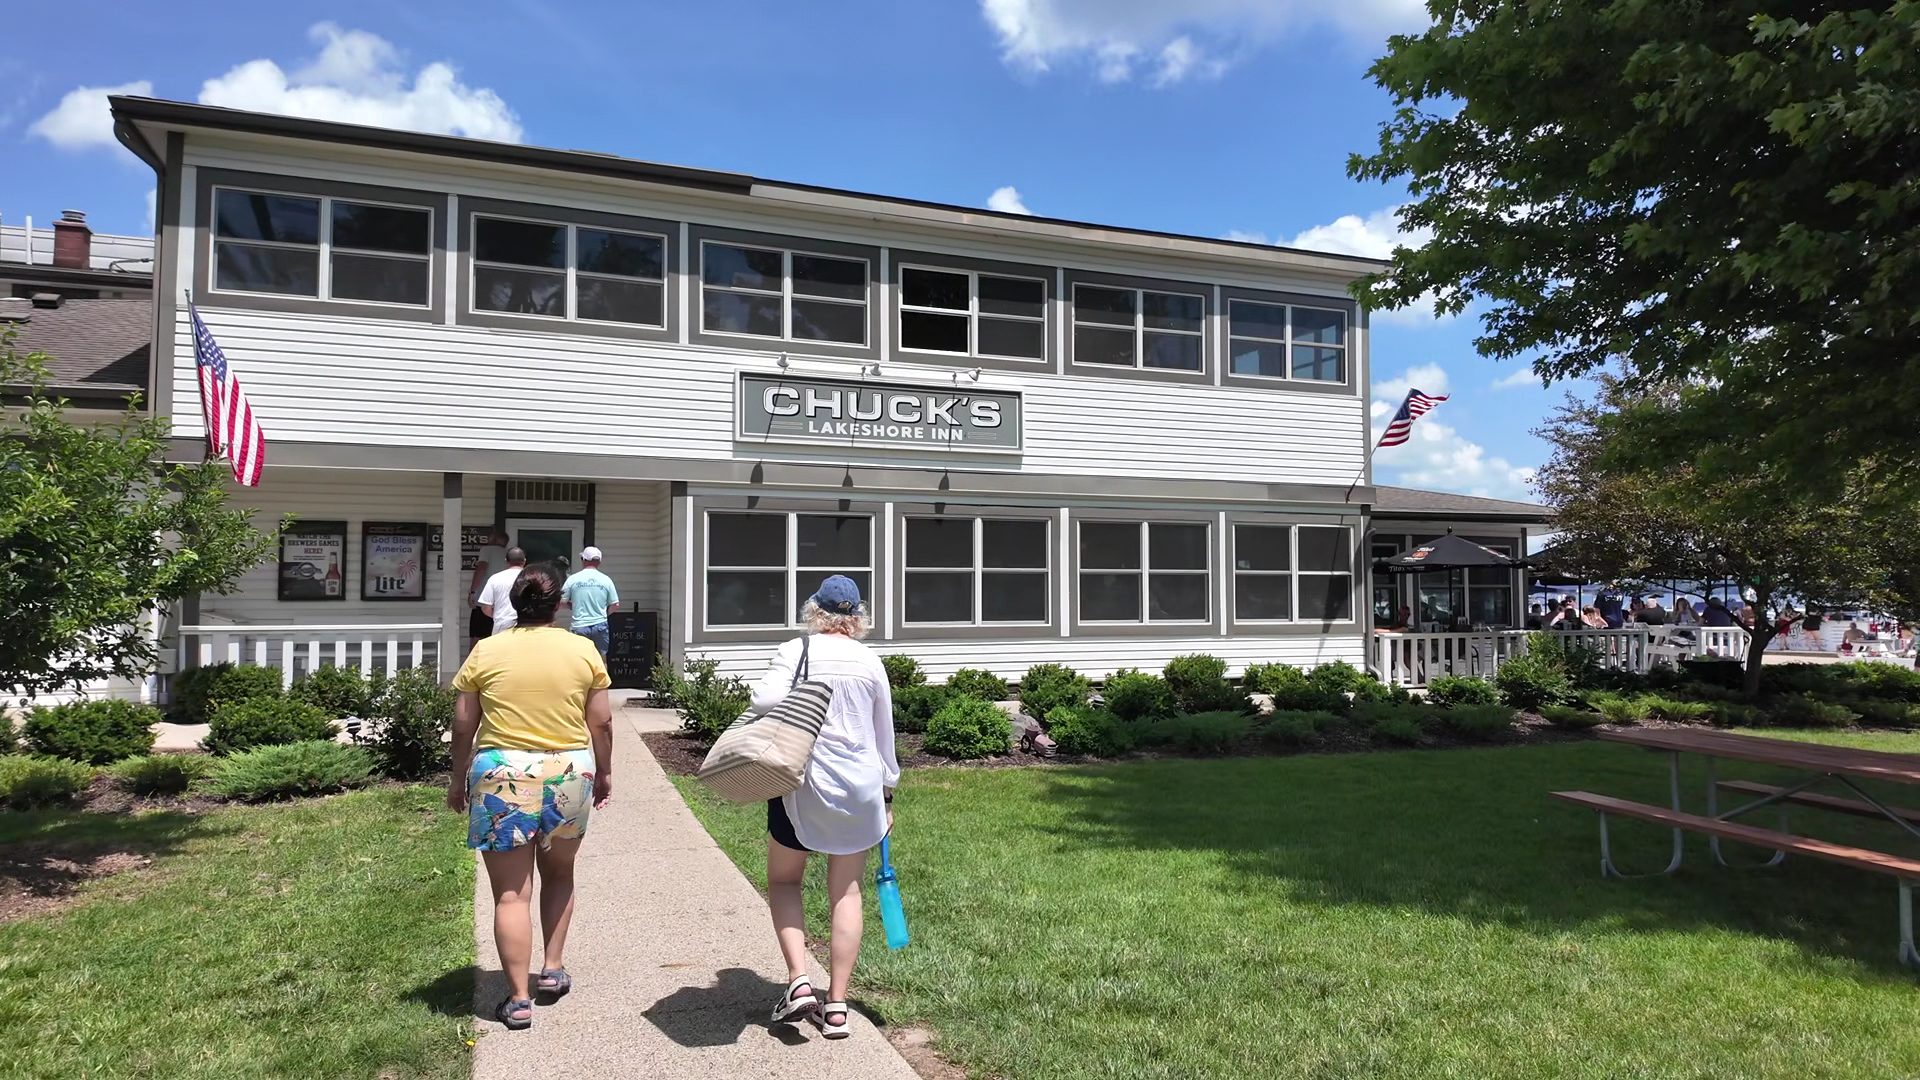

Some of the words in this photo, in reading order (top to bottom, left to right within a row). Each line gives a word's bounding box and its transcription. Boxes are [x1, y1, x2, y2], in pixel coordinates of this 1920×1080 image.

[763, 386, 1002, 428] CHUCK'S
[808, 420, 924, 439] LAKESHORE
[931, 427, 963, 440] INN
[371, 536, 390, 544] God
[432, 534, 488, 544] CCK'S
[375, 545, 412, 553] America
[374, 576, 406, 593] Lite
[613, 632, 634, 640] MUST
[636, 632, 645, 640] BE
